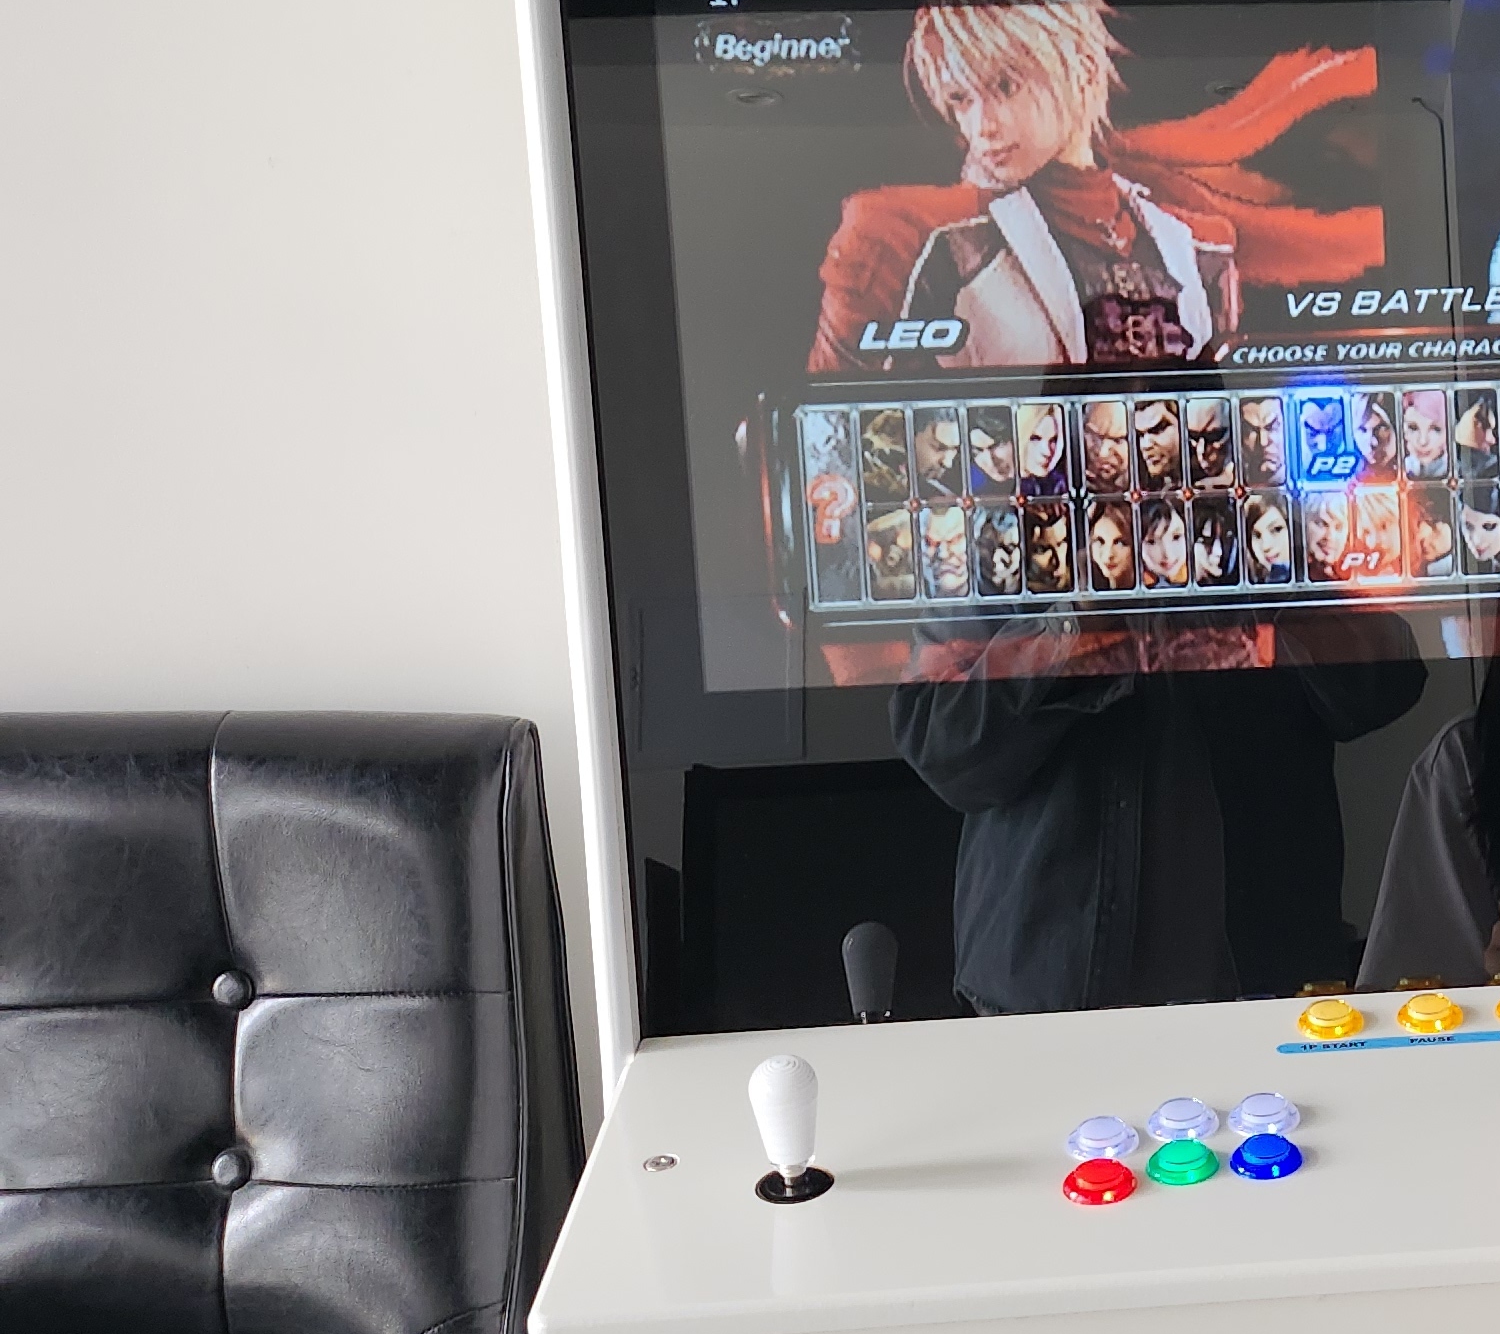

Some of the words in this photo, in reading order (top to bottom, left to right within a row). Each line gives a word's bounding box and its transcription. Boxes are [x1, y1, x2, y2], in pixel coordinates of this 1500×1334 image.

[714, 32, 851, 67] Beginner
[1285, 290, 1343, 318] VS
[858, 319, 964, 351] LEO
[1231, 344, 1329, 365] CHOOSE
[1336, 341, 1402, 361] YOUR
[1310, 455, 1356, 477] P2
[1341, 550, 1381, 570] P1
[1322, 1041, 1367, 1050] START
[1409, 1035, 1456, 1044] PAUSE
